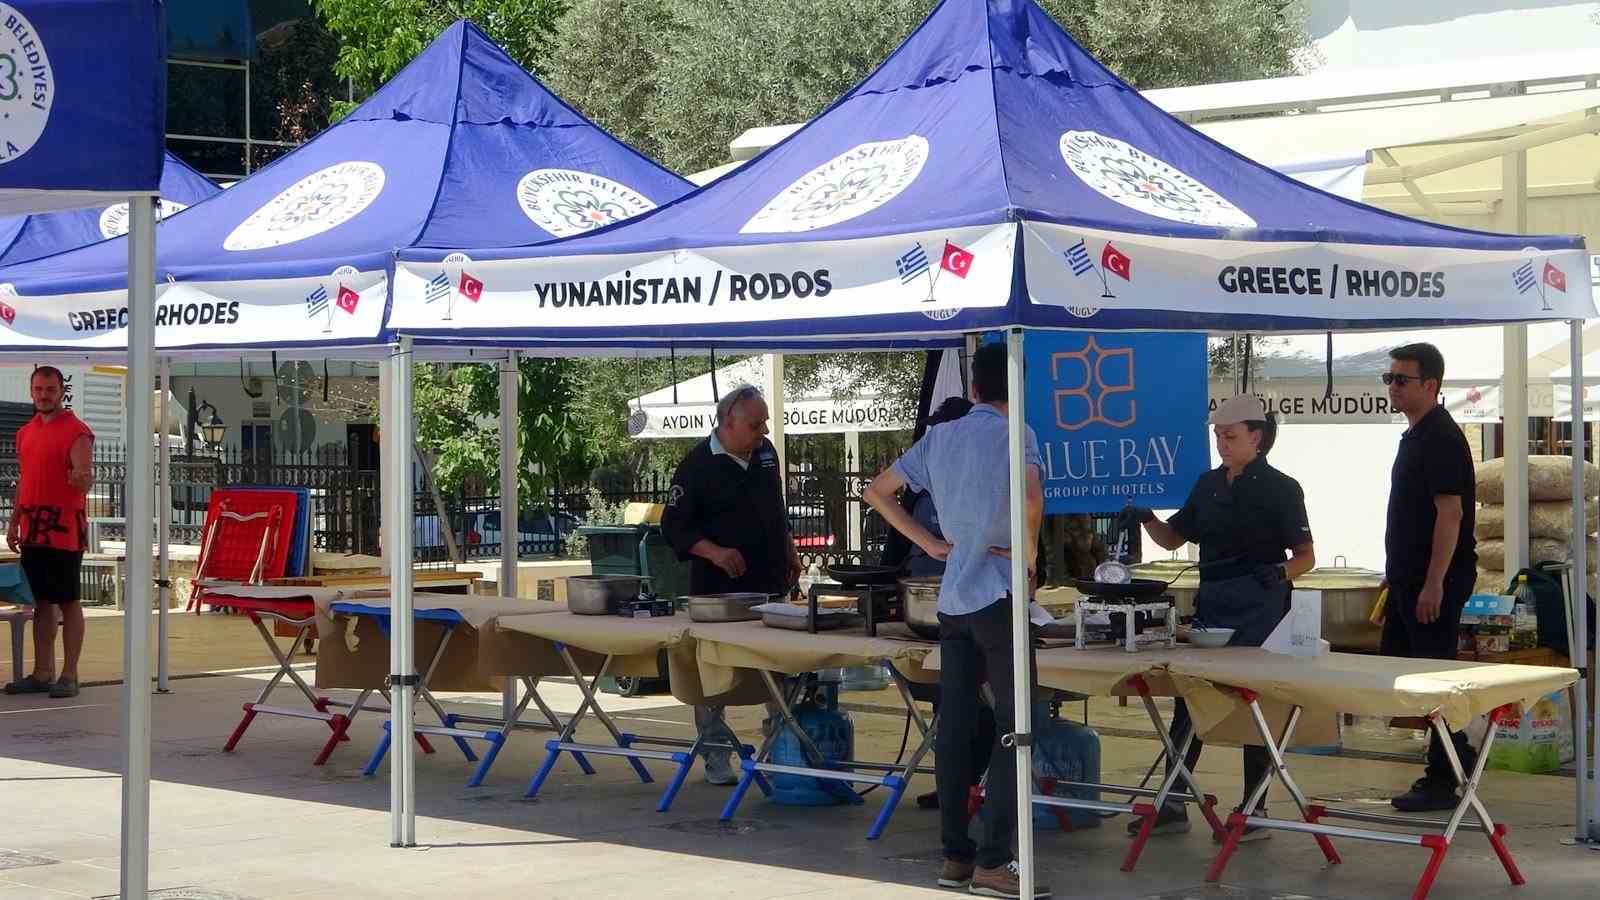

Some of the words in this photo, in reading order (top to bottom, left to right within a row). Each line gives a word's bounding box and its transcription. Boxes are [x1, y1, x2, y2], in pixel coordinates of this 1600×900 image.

[534, 269, 701, 308] YUNANİSTAN
[729, 268, 832, 301] RODOS
[1218, 265, 1323, 294] GREECE
[1346, 269, 1446, 298] RHODES
[68, 307, 129, 332] GREEC
[155, 301, 240, 326] RHODES
[1256, 392, 1305, 415] ÖLGE
[662, 414, 703, 429] AYDIN
[1039, 439, 1111, 481] LUE
[1119, 434, 1182, 477] BAY
[1044, 485, 1089, 498] GROUP
[1092, 484, 1107, 497] OF
[1111, 483, 1165, 496] HOTELS
